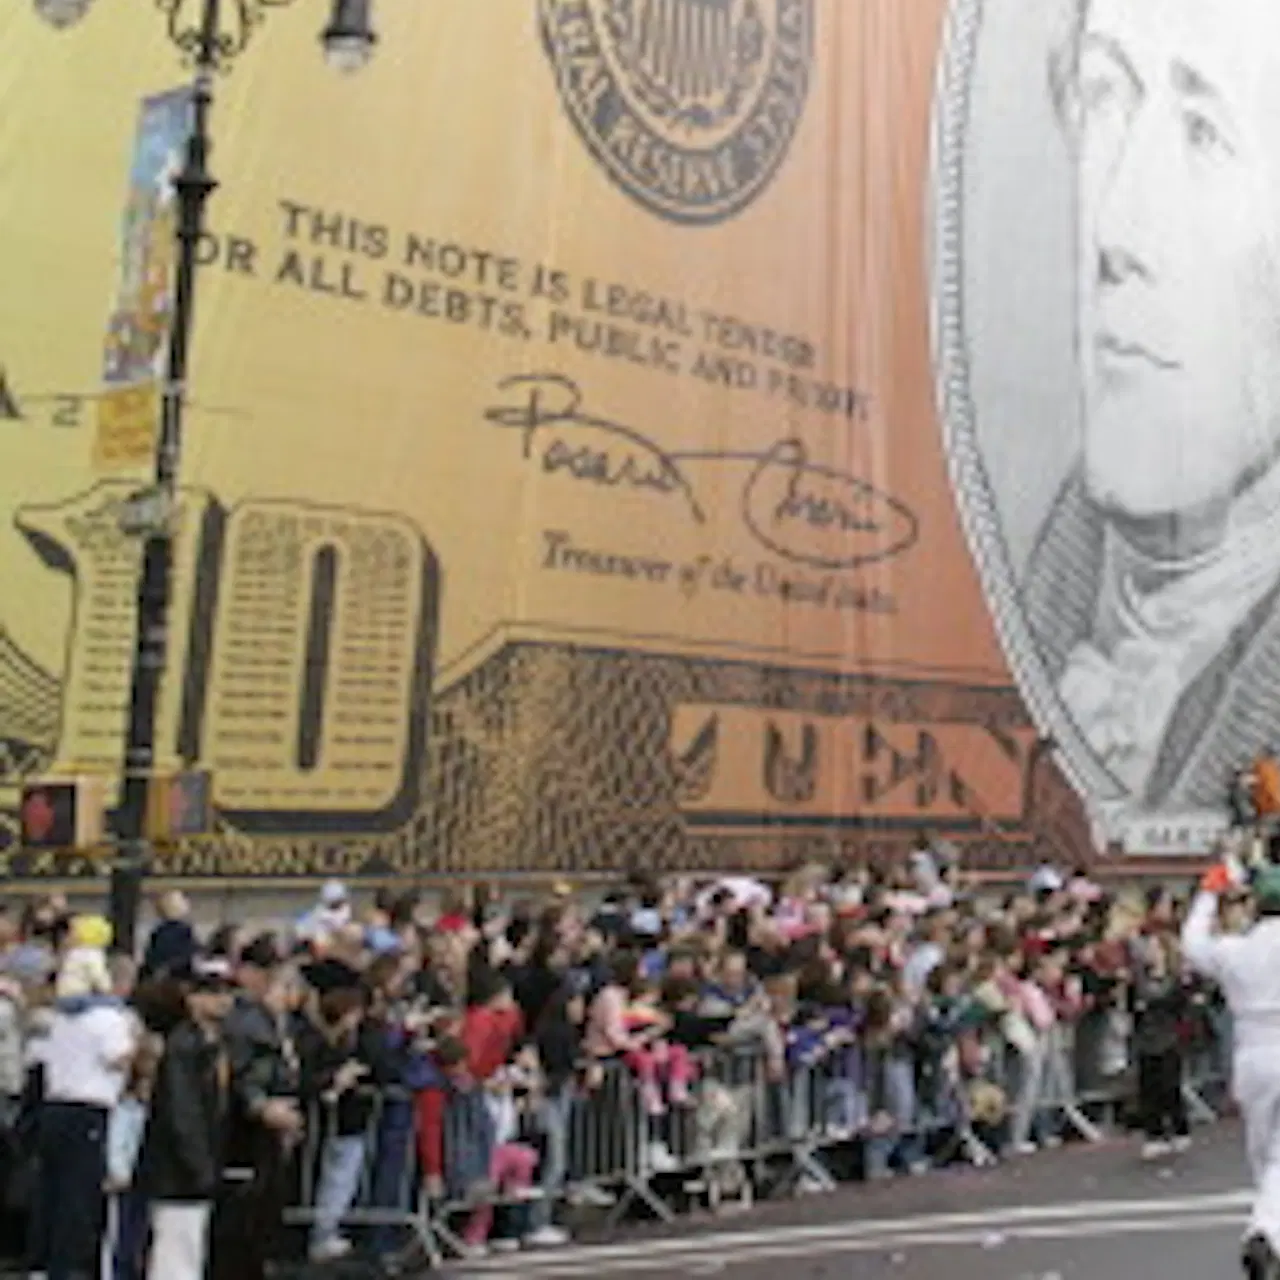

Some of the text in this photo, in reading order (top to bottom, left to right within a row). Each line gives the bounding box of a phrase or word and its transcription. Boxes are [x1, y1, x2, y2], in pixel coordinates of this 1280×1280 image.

[273, 250, 369, 301] ALL
[380, 270, 532, 341] DEBTS,
[547, 310, 681, 376] PUBLIC
[690, 352, 757, 391] AND
[278, 197, 390, 260] THIS
[404, 232, 519, 292] NOTE
[530, 263, 571, 303] IS
[581, 277, 694, 337] LEGAL
[12, 476, 442, 838] 10
